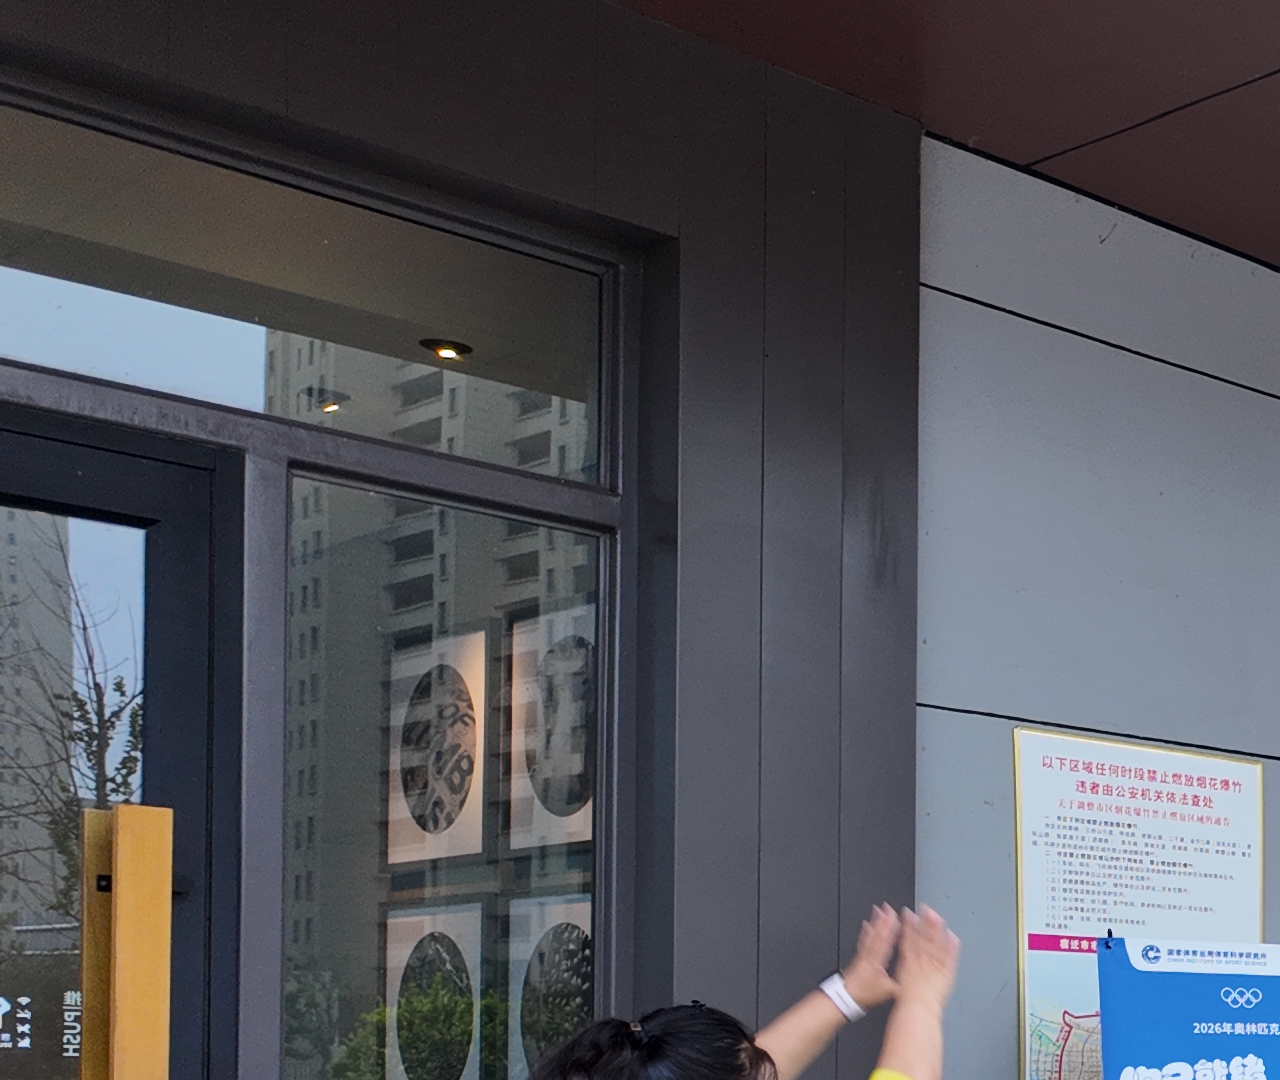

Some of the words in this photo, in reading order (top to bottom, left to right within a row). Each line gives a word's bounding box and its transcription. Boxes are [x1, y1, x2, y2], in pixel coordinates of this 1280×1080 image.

[1042, 755, 1243, 794] 以下区域任何时段禁止燃放烟花爆竹
[1075, 779, 1214, 809] 违者由公安机关依法查处
